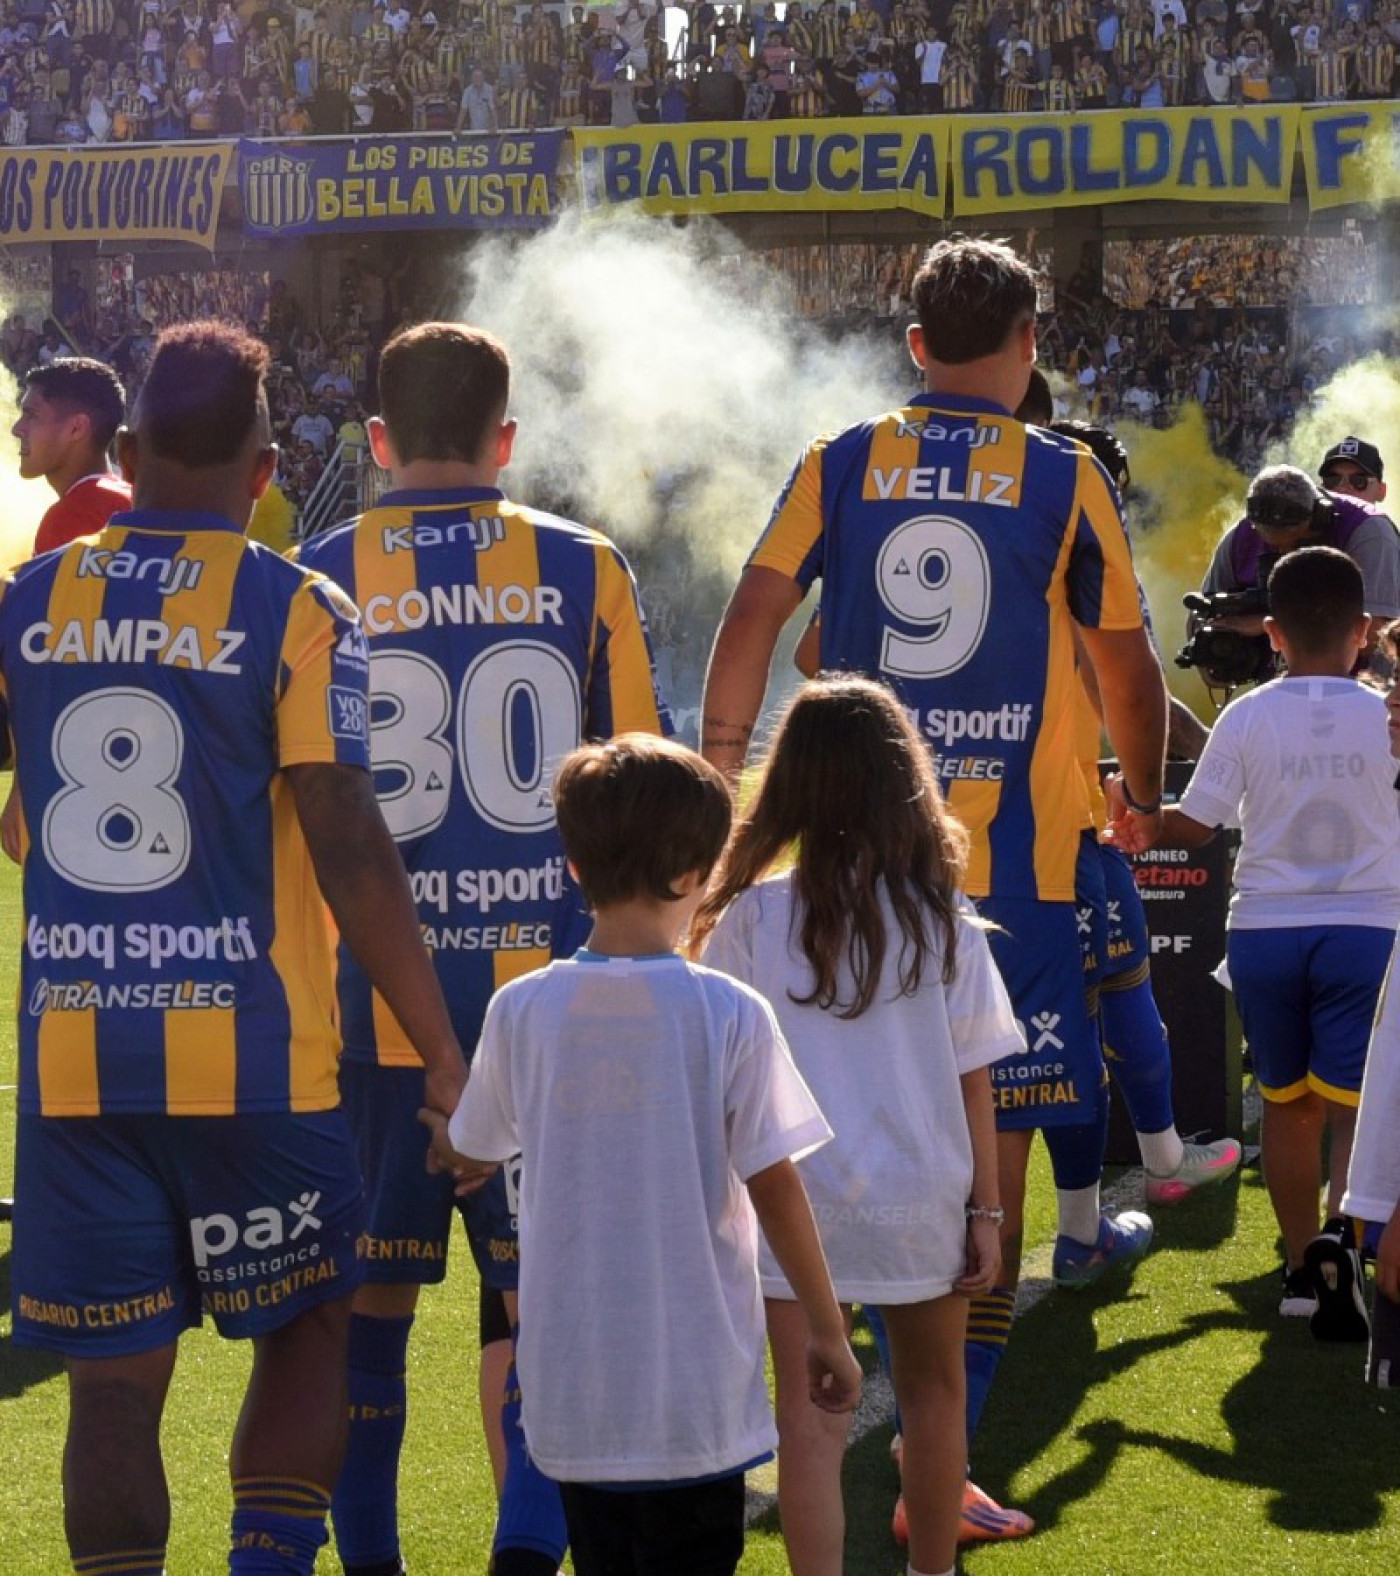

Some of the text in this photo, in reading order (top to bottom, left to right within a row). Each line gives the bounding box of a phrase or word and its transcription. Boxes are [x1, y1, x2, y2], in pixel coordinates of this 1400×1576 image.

[347, 141, 536, 173] LOS PIBES DE
[960, 115, 1282, 197] ROLDAN
[1312, 112, 1374, 189] F
[43, 153, 222, 236] POLVORINES
[315, 172, 550, 222] BELLA VISTA
[895, 420, 1000, 448] kanji
[872, 466, 1017, 507] VELIZ
[382, 516, 506, 554] kanji
[77, 546, 204, 595] kanji
[364, 583, 565, 634] CONNOR
[875, 514, 991, 680] 9
[20, 618, 247, 675] CAMPAZ
[367, 638, 582, 843] 30
[925, 703, 1033, 747] sportif
[41, 685, 192, 894] 8
[1280, 752, 1366, 781] MATEO
[455, 855, 564, 913] sporti
[1135, 865, 1208, 886] etano
[1140, 888, 1186, 900] lausura
[422, 923, 552, 950] ANSELEC
[1151, 934, 1192, 953] PF
[49, 983, 236, 1011] TRANSELEC
[189, 1190, 323, 1267] pax
[197, 1242, 321, 1283] assistance
[255, 1258, 340, 1307] CENTRAL
[19, 1286, 176, 1328] ROSARIO CENTRAL
